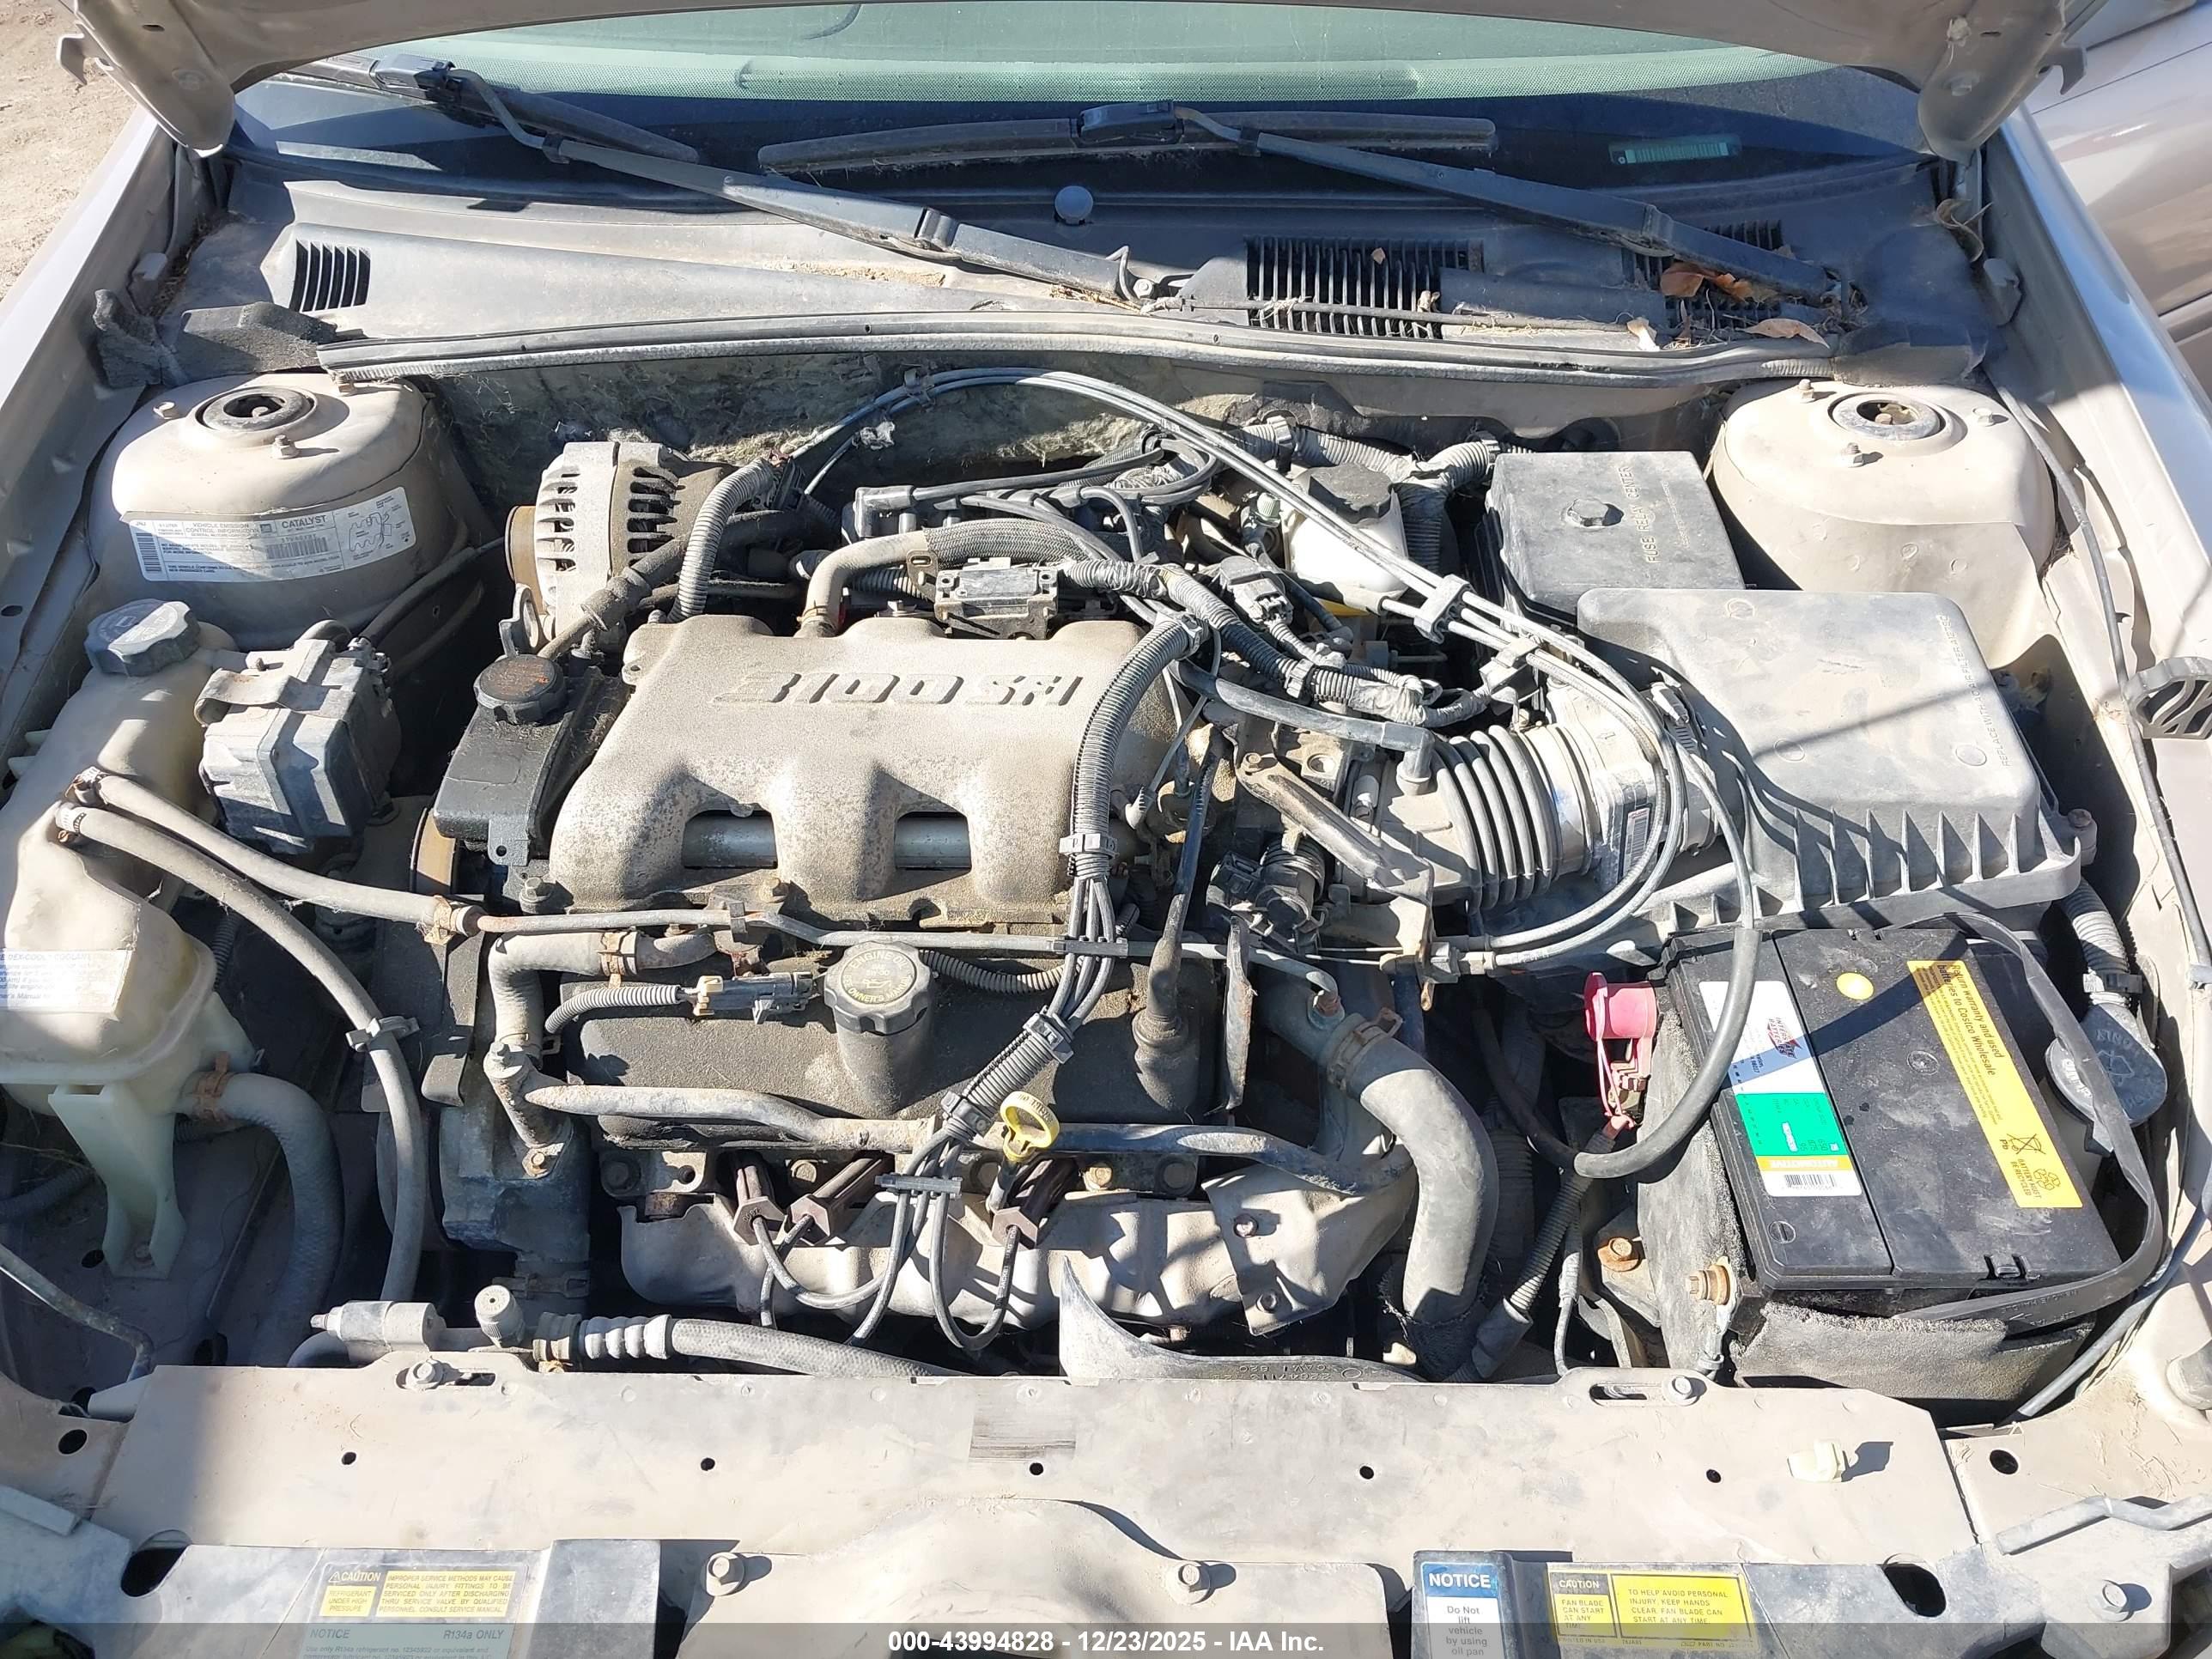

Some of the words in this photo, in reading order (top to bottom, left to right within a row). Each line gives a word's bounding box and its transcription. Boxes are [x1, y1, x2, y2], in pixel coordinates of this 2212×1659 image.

[1618, 466, 1640, 500] CENTER
[282, 515, 327, 528] CATALYST
[1641, 536, 1662, 563] FUSE
[849, 951, 893, 969] ENGINE
[1950, 965, 1968, 992] Return
[1963, 990, 1984, 1022] warranty
[1979, 1024, 1994, 1038] and
[1987, 1037, 2006, 1058] used
[1937, 964, 1958, 997] batteries
[1958, 1008, 1976, 1034] Costco
[1971, 1036, 1996, 1076] Wholesale
[1999, 1139, 2009, 1150] Pb
[342, 1571, 381, 1582] CAUTION
[1428, 1573, 1492, 1589] NOTICE
[1559, 1579, 1600, 1589] CAUTION
[1463, 1606, 1480, 1614] Not
[1458, 1615, 1471, 1624] lift
[310, 1629, 350, 1638] NOTICE
[443, 1630, 472, 1639] R134a
[476, 1630, 505, 1639] ONLY
[1449, 1626, 1483, 1635] vehicle
[1446, 1636, 1458, 1646] by
[1461, 1637, 1487, 1647] using
[1467, 1649, 1484, 1657] pan
